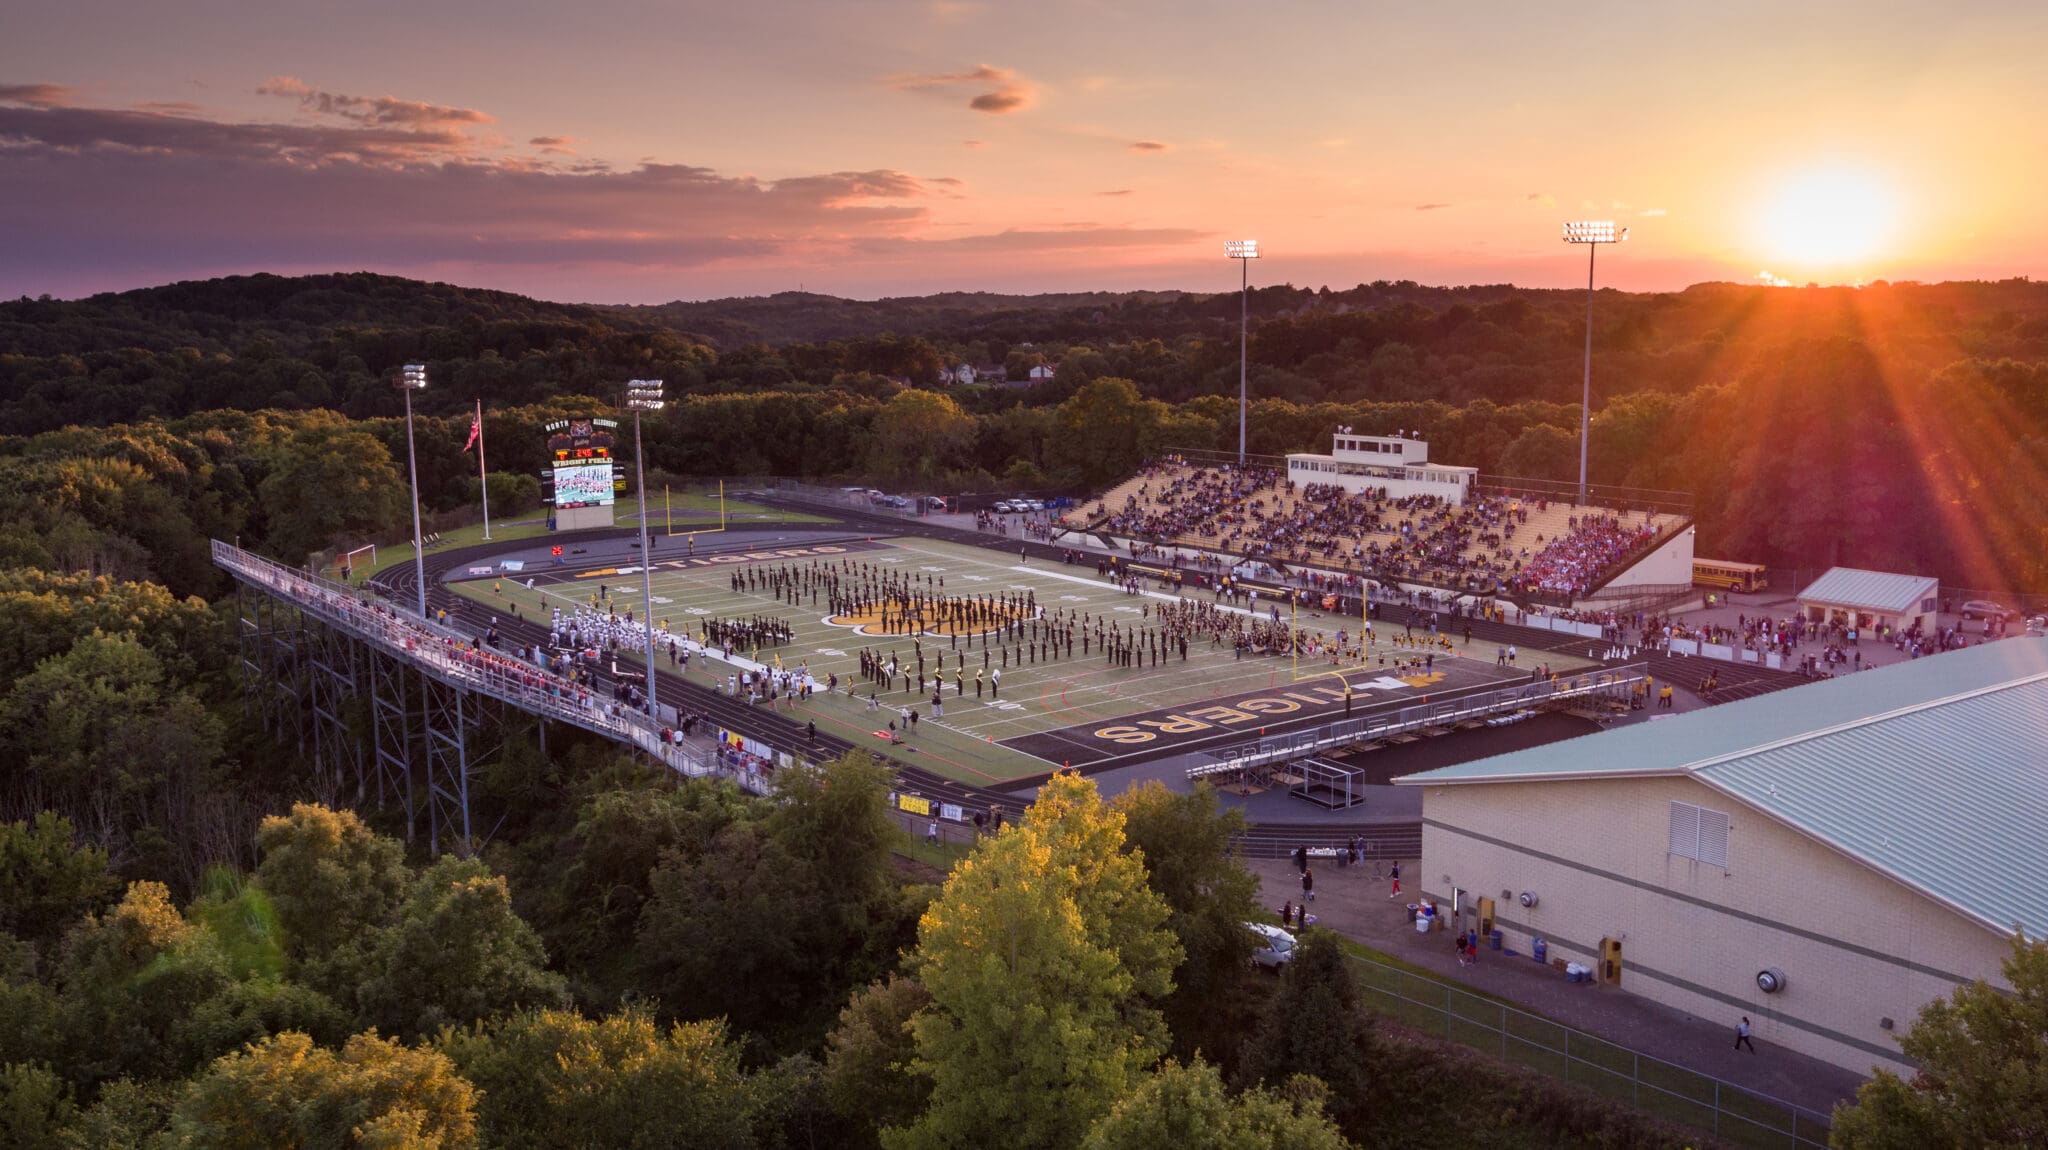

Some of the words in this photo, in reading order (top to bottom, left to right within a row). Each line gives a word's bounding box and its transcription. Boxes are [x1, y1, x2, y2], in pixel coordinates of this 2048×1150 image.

[545, 420, 569, 432] NORTH
[655, 546, 847, 568] TIGERS
[1094, 687, 1373, 744] TIGERS
